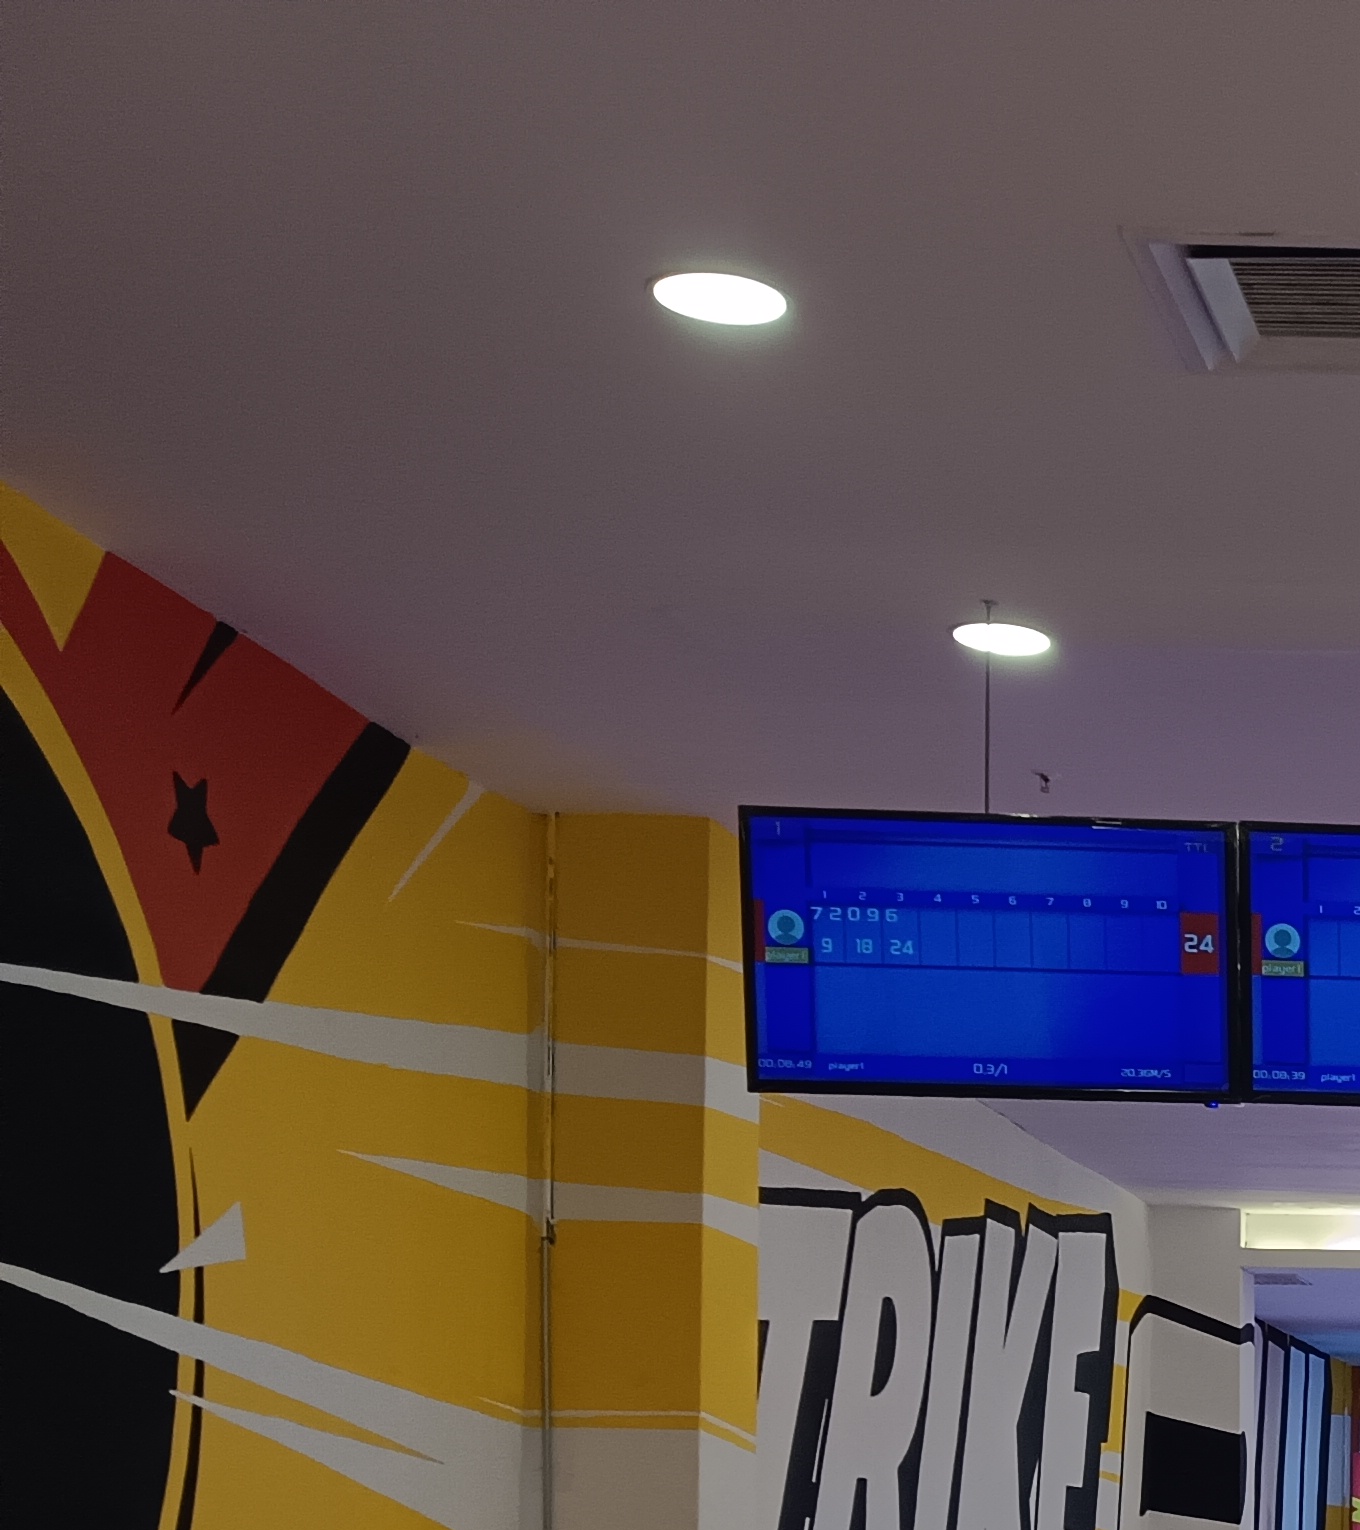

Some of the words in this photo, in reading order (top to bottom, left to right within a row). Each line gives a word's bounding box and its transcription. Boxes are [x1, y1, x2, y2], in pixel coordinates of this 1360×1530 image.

[858, 891, 867, 901] 2
[897, 892, 904, 902] 3
[933, 893, 942, 903] 4
[971, 894, 980, 904] 5
[1008, 895, 1017, 906] 6
[1046, 897, 1055, 906] 7
[1120, 899, 1129, 909] 9
[1156, 900, 1168, 910] 10
[810, 906, 823, 920] 7
[829, 906, 842, 921] 2
[847, 906, 861, 921] 0
[866, 908, 879, 922] 9
[885, 908, 898, 923] 6
[821, 937, 833, 953] 9
[855, 938, 873, 954] 18
[890, 939, 914, 955] 24
[1184, 933, 1214, 954] 24
[1320, 1073, 1356, 1084] player1
